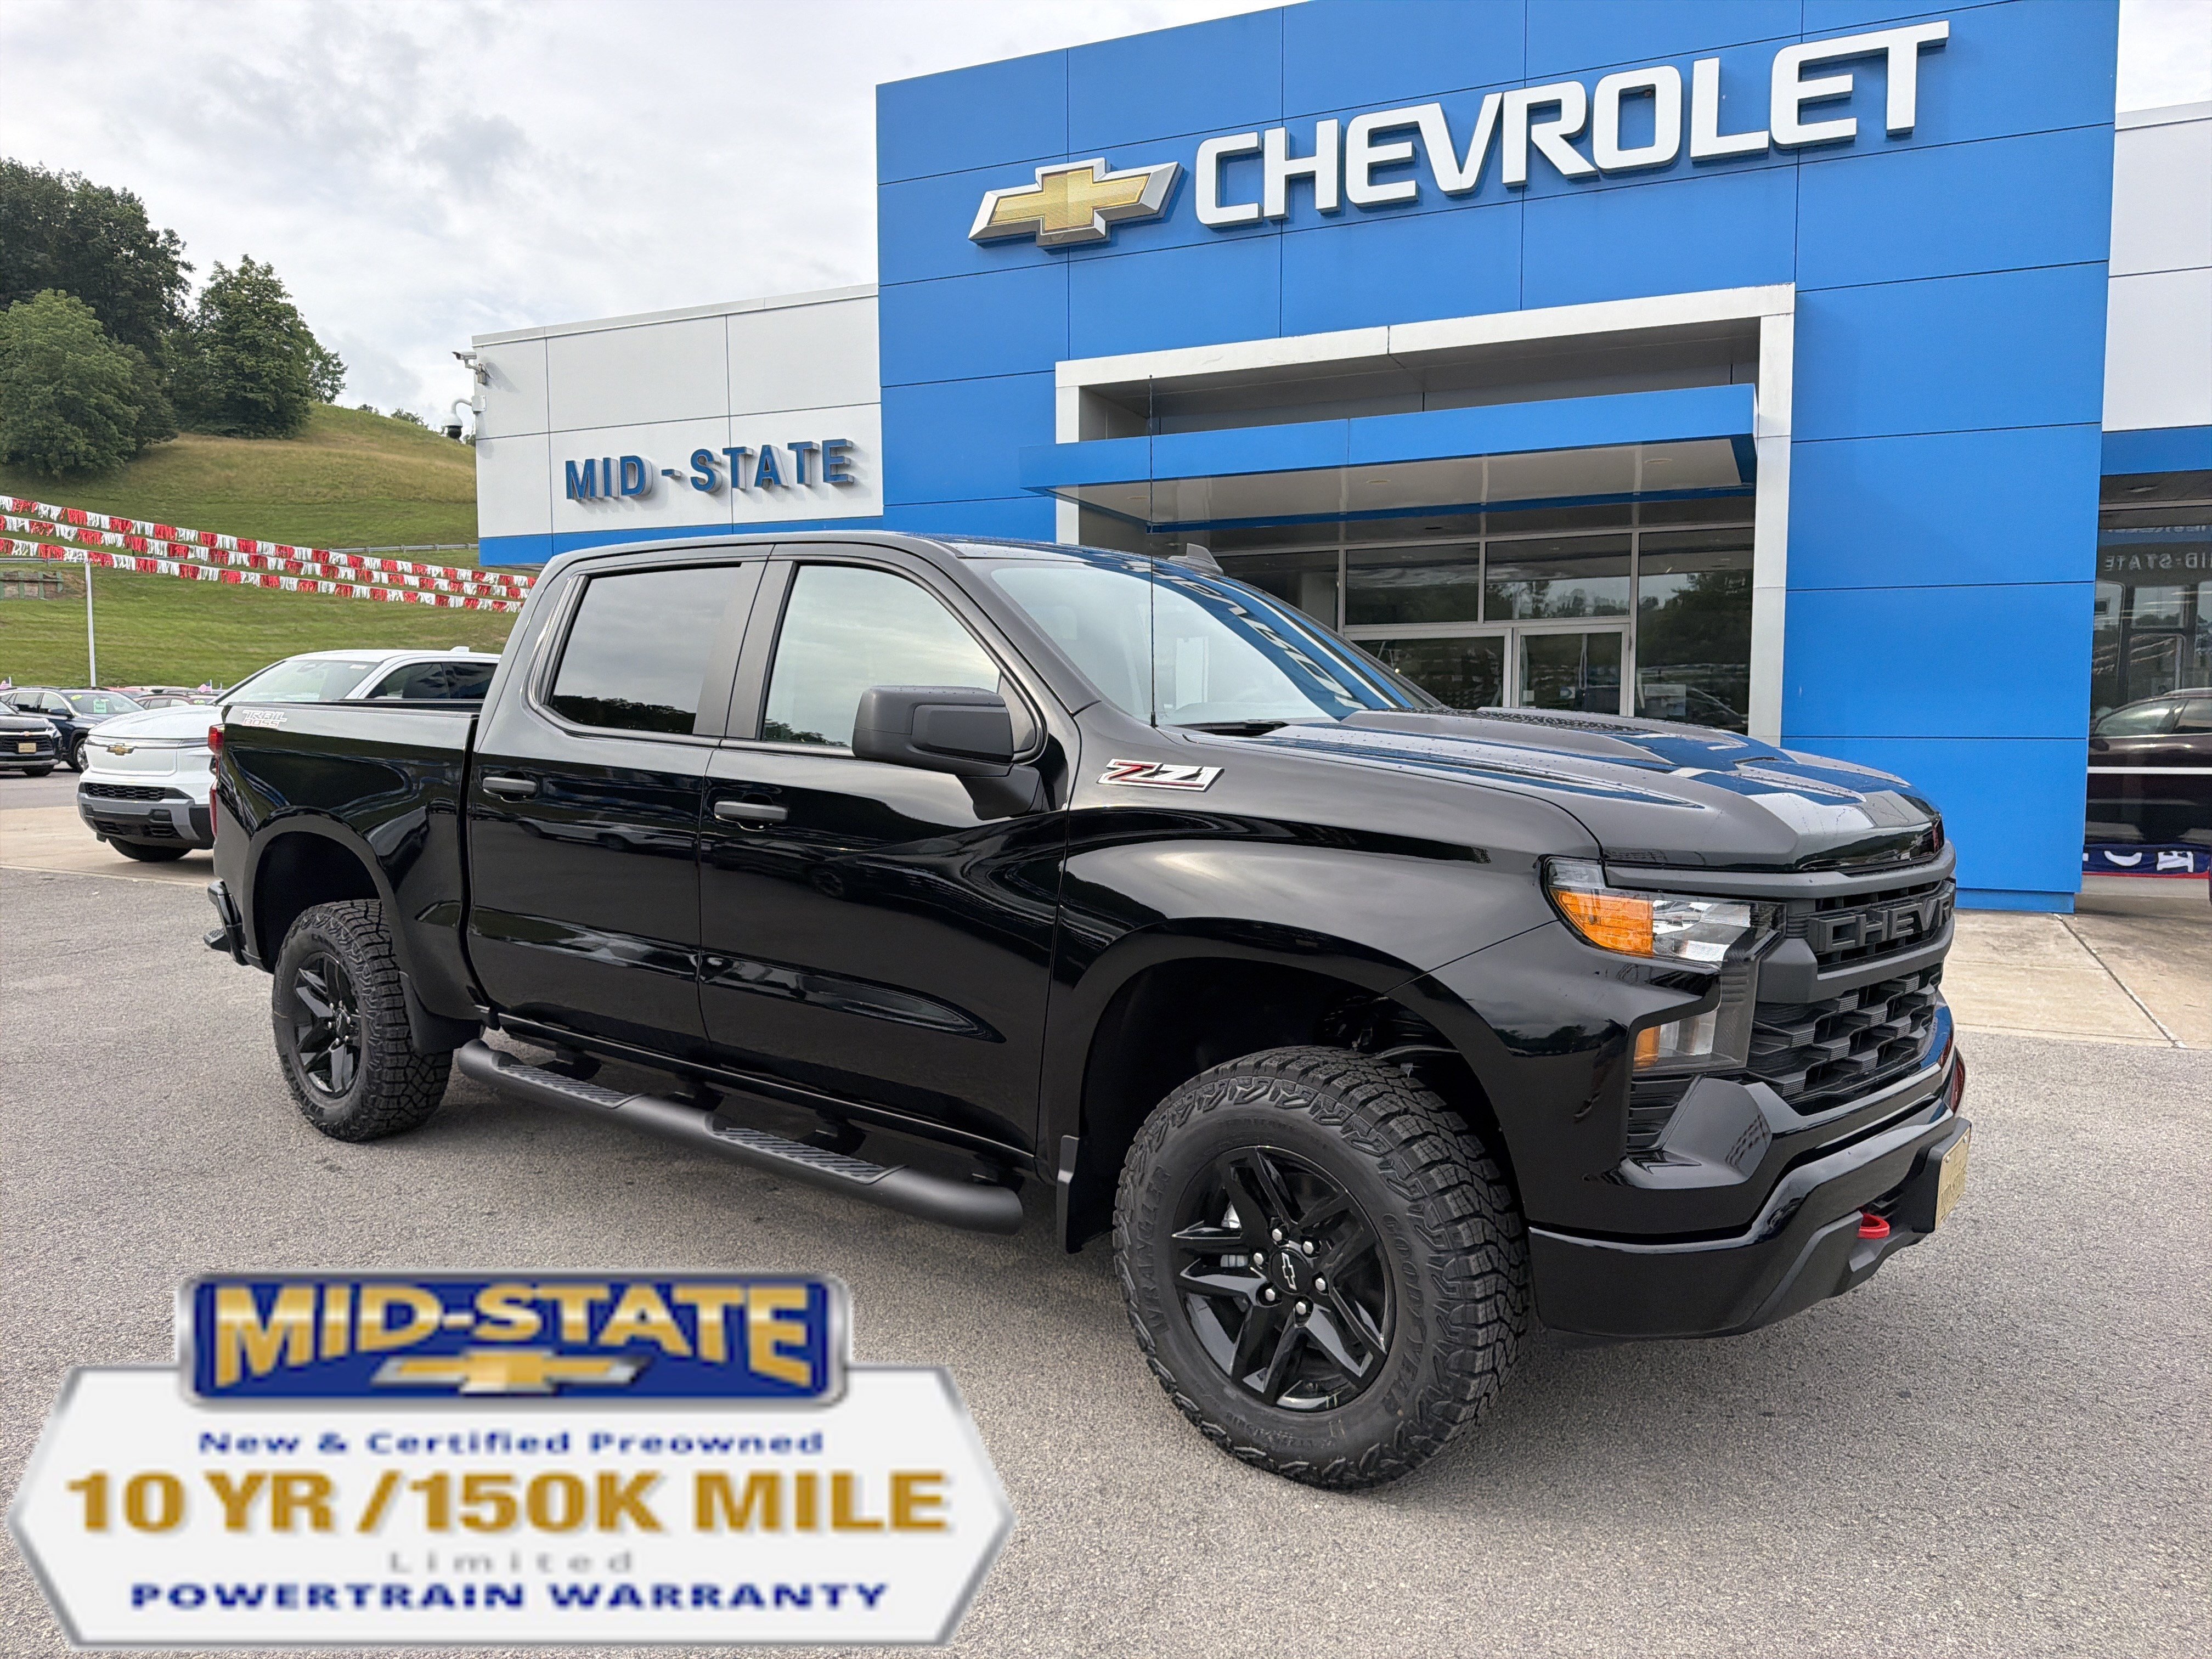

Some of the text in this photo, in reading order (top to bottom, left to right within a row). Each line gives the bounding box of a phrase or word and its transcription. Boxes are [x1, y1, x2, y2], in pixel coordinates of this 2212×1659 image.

[1195, 19, 1949, 228] CHEVROLET
[242, 709, 288, 722] TRAIL
[242, 719, 280, 728] BOSS
[1096, 758, 1225, 792] Z71
